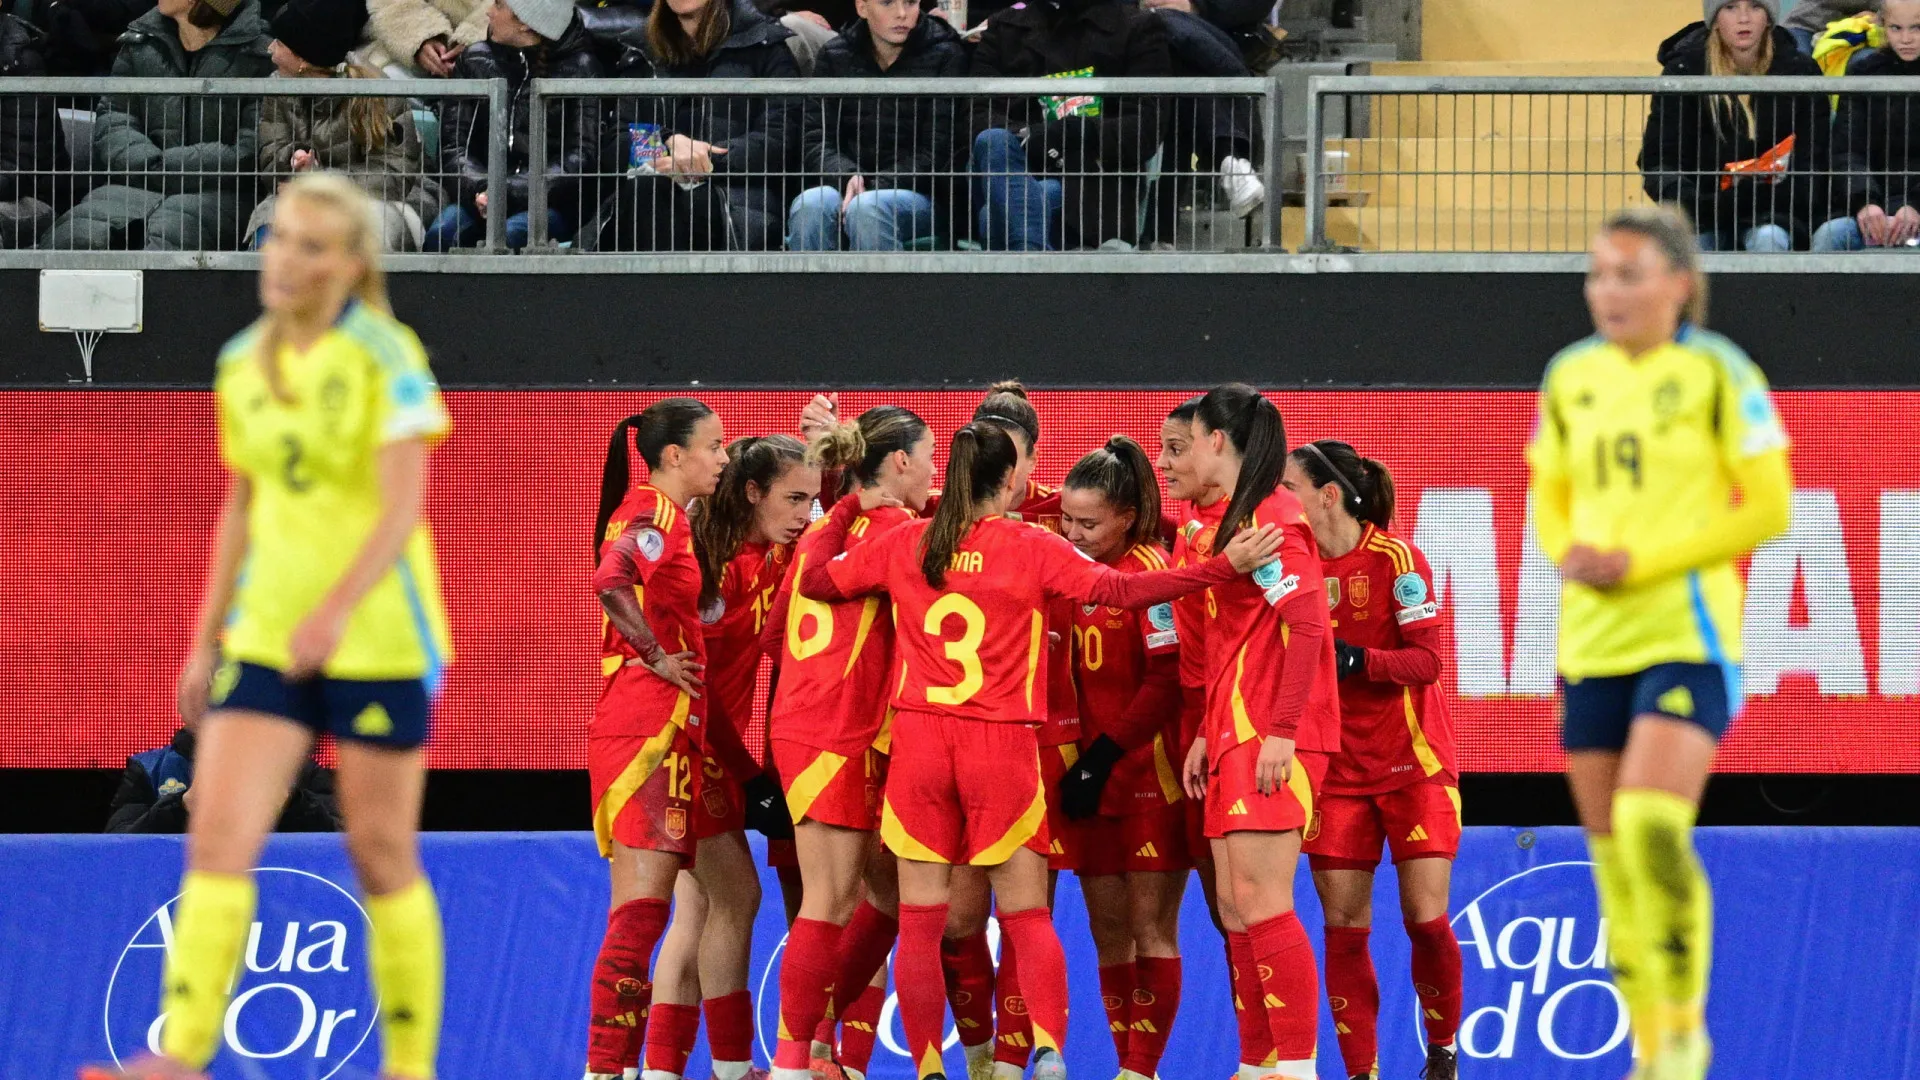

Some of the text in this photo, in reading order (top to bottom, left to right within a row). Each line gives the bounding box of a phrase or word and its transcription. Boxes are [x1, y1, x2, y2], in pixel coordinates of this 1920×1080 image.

[280, 433, 313, 492] 2
[1595, 433, 1642, 489] 19
[787, 553, 834, 661] 6
[924, 592, 985, 705] 3
[663, 751, 691, 801] 12
[128, 905, 349, 994] Aua
[1458, 901, 1610, 994] Aqu
